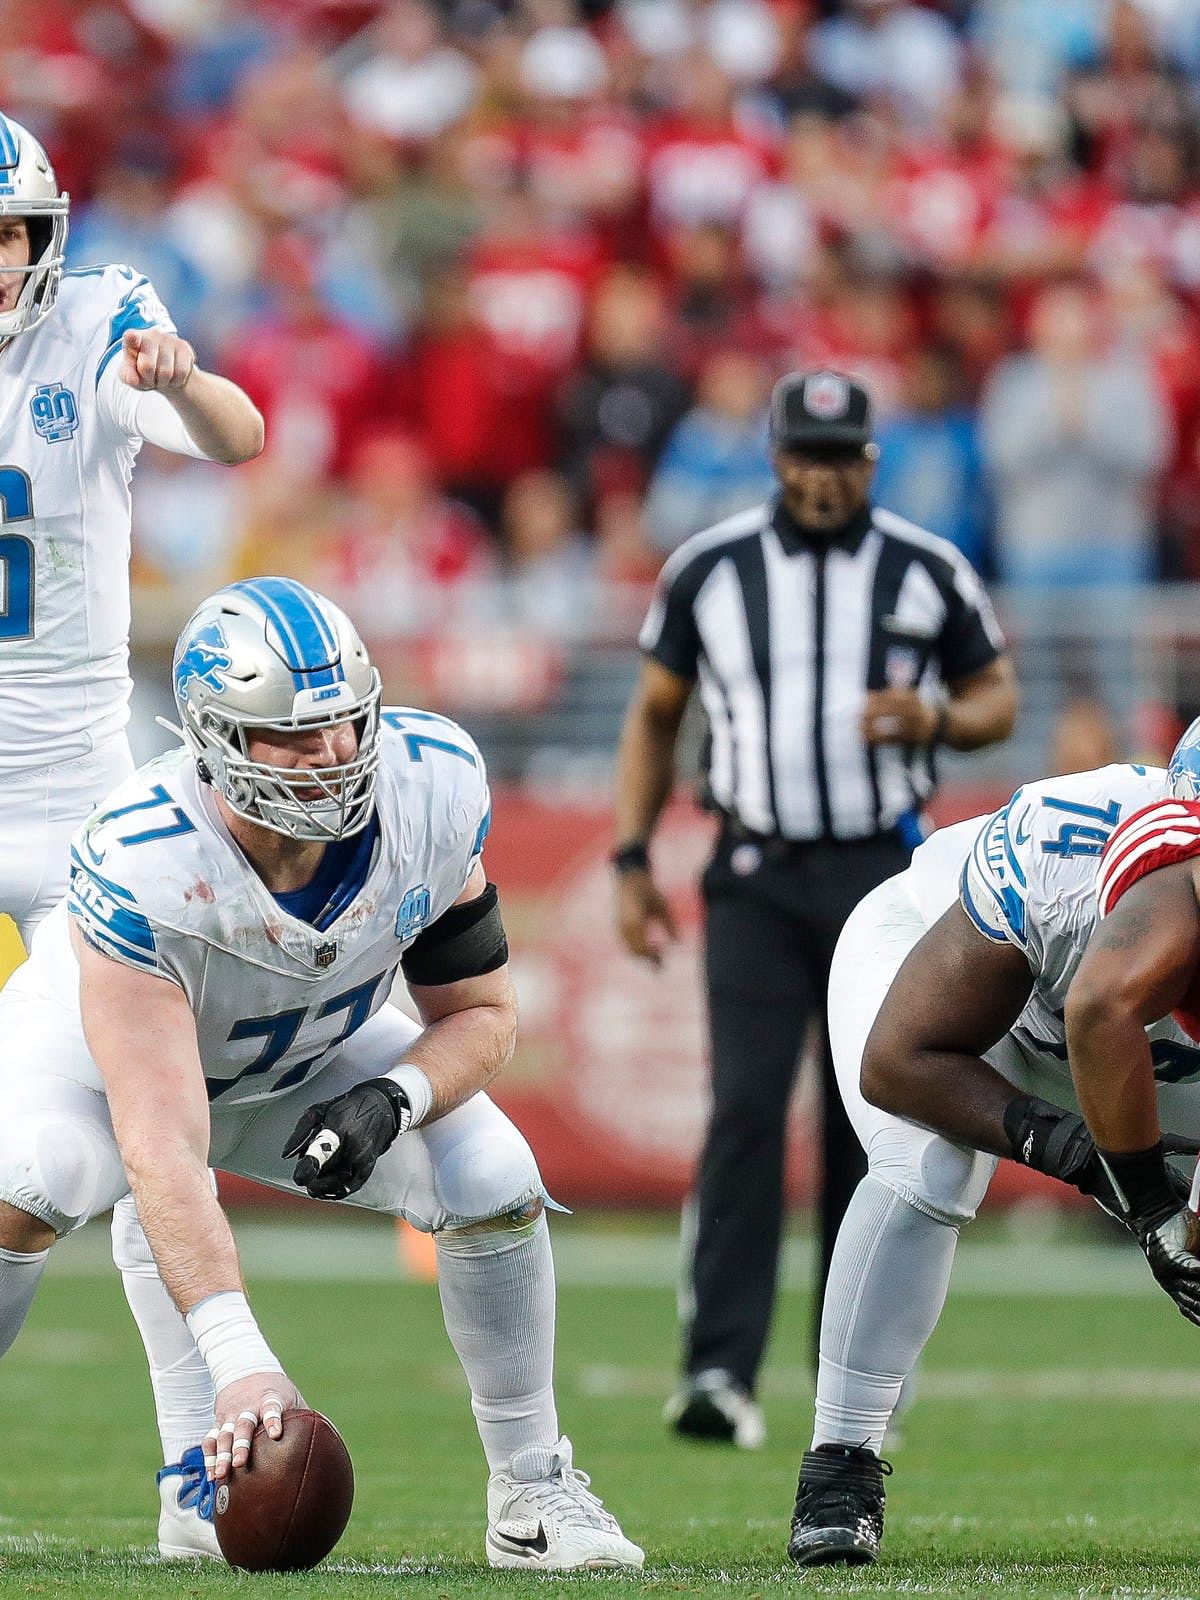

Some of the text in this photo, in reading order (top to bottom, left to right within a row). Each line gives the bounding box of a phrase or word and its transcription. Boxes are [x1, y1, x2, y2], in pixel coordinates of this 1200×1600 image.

[33, 391, 75, 424] 90
[98, 783, 200, 848] 77
[1040, 796, 1123, 860] 74
[205, 967, 390, 1102] 77
